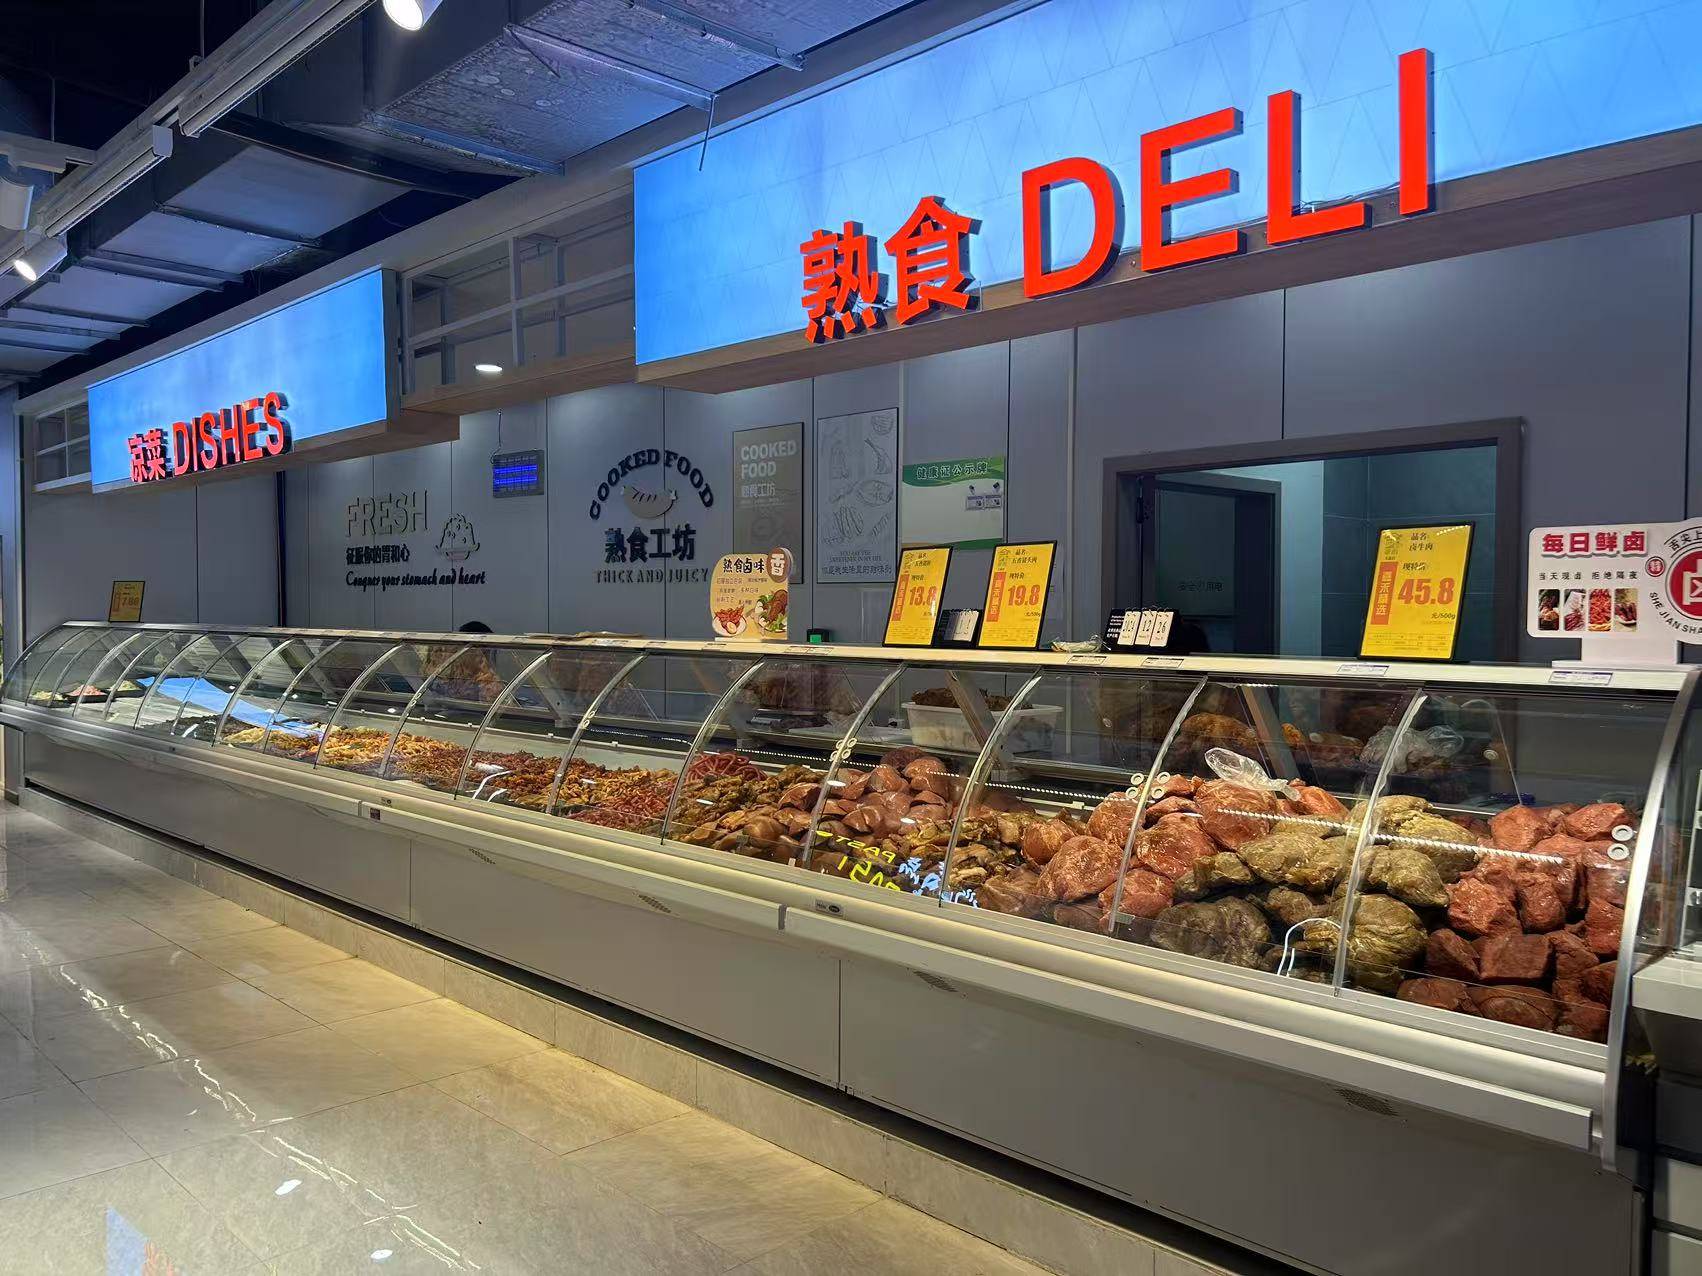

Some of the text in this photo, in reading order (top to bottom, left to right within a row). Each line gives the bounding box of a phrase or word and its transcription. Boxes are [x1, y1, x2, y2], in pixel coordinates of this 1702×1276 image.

[800, 47, 1432, 344] 熟食 DELI
[128, 391, 290, 482] 凉菜 DISHES
[740, 439, 797, 461] COOKED
[740, 461, 777, 479] FOOD
[589, 449, 660, 520] COOKED
[664, 450, 714, 508] FOOD
[346, 489, 428, 538] FRESH
[604, 523, 696, 563] 熟食工坊
[1541, 530, 1645, 553] 每日鲜卤
[381, 573, 400, 591] your
[401, 568, 437, 586] stomach
[439, 569, 456, 584] and
[458, 567, 486, 584] heart
[595, 569, 634, 584] THICK
[637, 569, 663, 583] AND
[668, 568, 708, 583] JUICY
[1539, 571, 1638, 580] 当天现卤 拒绝隔夜
[1007, 584, 1041, 607] 19.8
[1397, 577, 1457, 605] 45.8
[1431, 612, 1456, 620] 元/500g
[1649, 591, 1664, 609] SHE
[1659, 611, 1681, 629] JIAN
